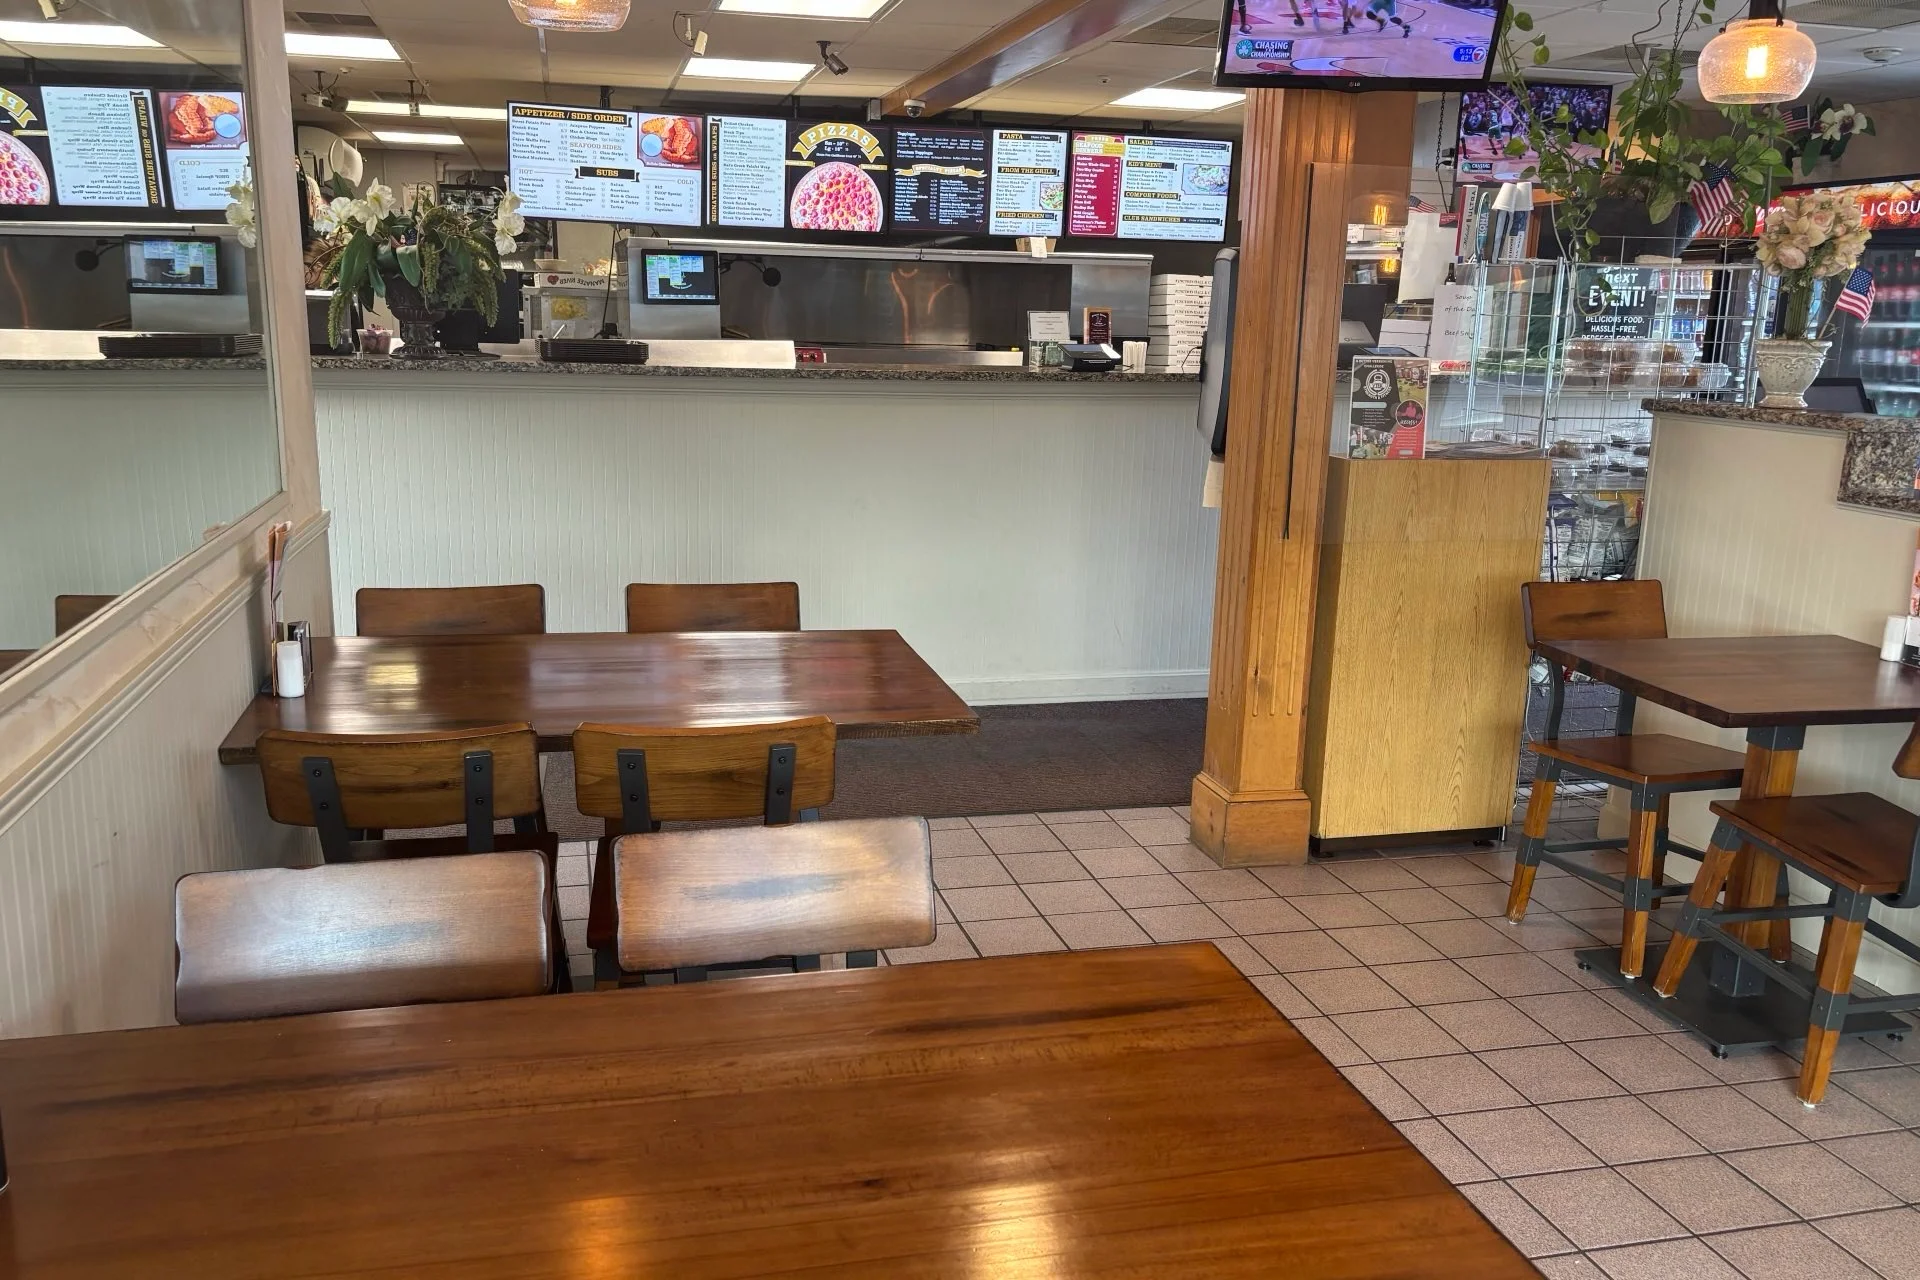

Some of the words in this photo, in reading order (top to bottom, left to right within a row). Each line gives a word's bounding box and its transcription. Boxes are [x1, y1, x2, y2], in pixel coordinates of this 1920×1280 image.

[1255, 41, 1288, 49] CHASING
[515, 108, 565, 119] APPETIZER
[571, 112, 592, 120] SIDE
[594, 114, 625, 123] ORDER
[807, 125, 871, 146] PIZZAS
[596, 169, 619, 177] SUBS
[1468, 191, 1476, 217] ULTRA
[1859, 200, 1920, 217] LICIOU
[1478, 213, 1489, 237] KONA
[559, 277, 576, 285] RIVER
[577, 278, 605, 286] MANATEE
[1605, 273, 1639, 284] next
[1588, 285, 1646, 307] EVENT!
[1591, 325, 1638, 334] HASSLE-FREE,
